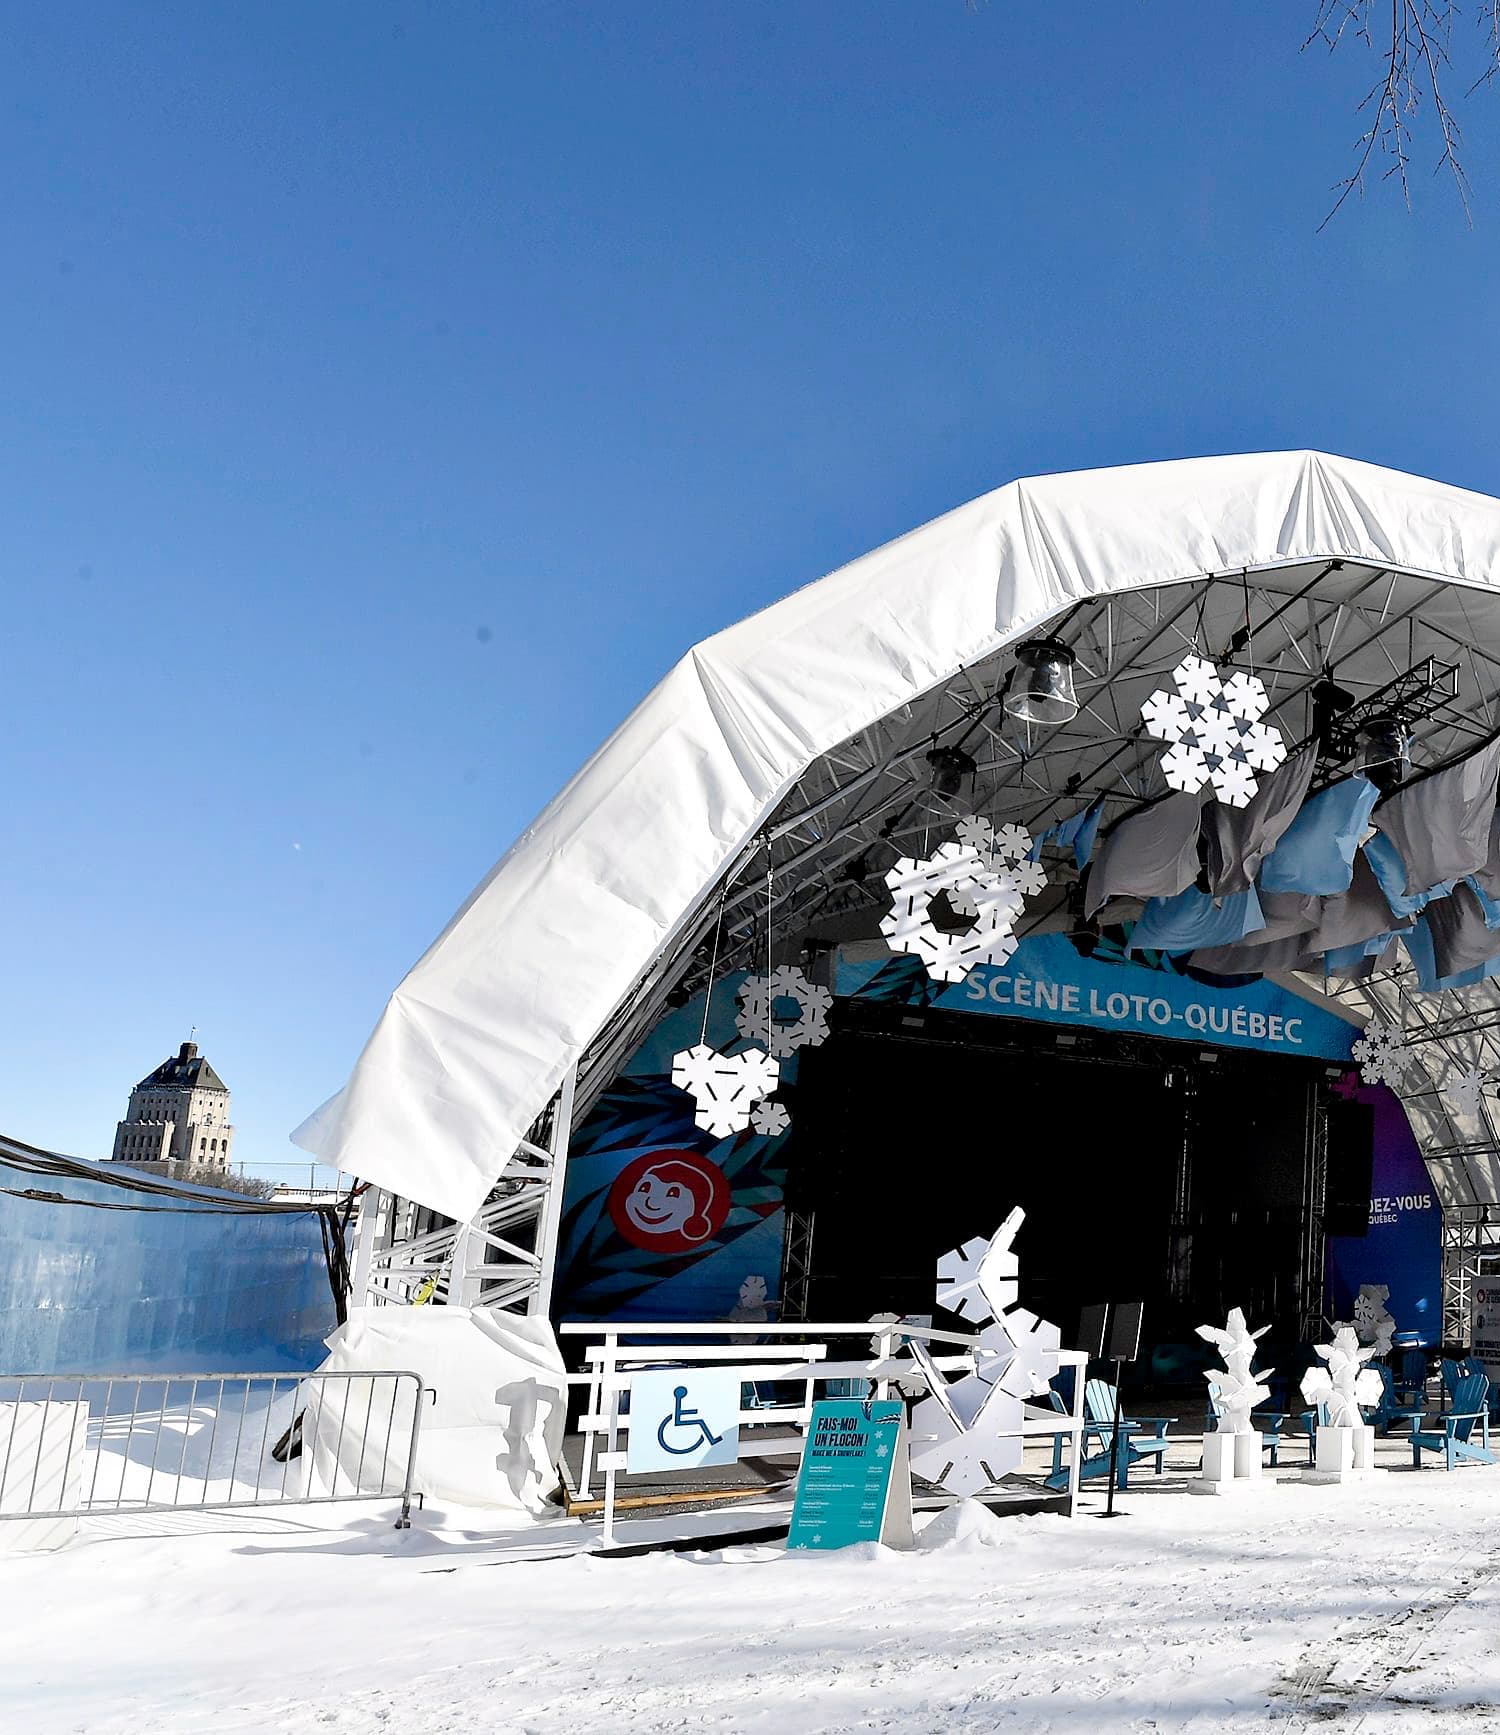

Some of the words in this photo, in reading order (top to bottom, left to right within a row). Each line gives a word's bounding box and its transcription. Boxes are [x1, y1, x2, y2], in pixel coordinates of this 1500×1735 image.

[966, 972, 1080, 1012] SCÈNE
[1089, 989, 1303, 1044] LOTO-QUÉBEC
[817, 1417, 858, 1431] FAIS-MOI
[814, 1433, 828, 1446] UN
[828, 1433, 863, 1447] FLOCON
